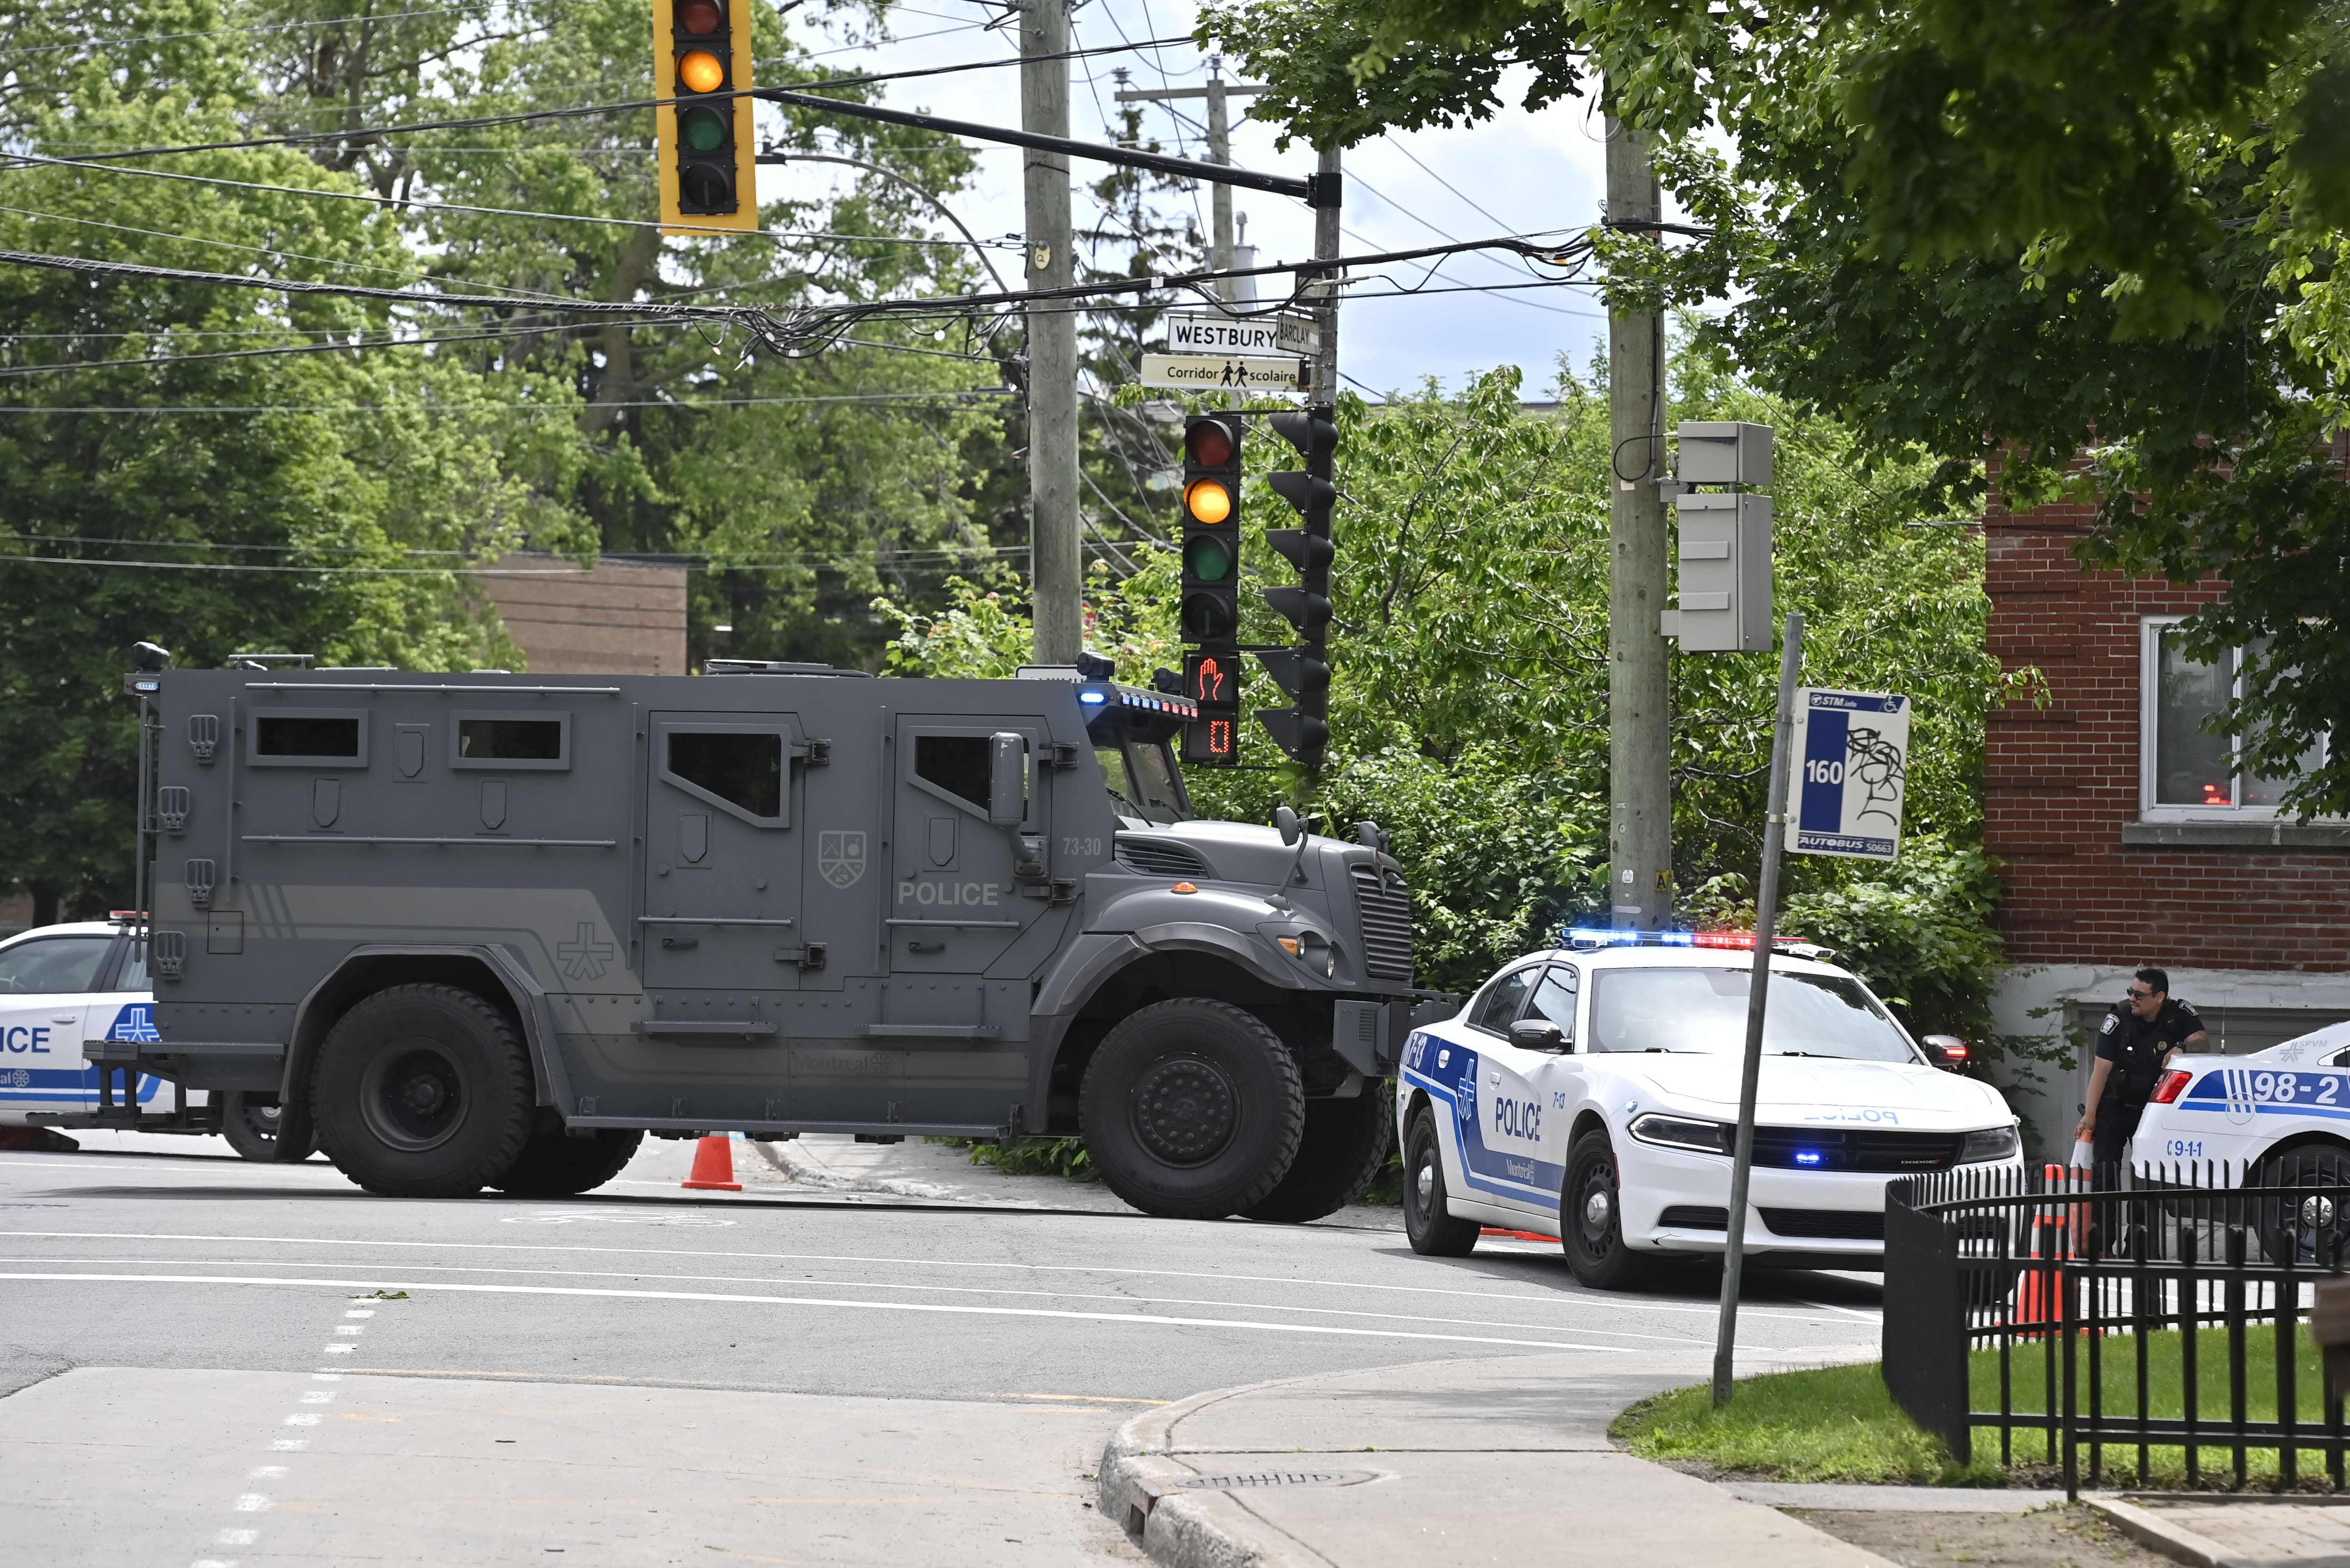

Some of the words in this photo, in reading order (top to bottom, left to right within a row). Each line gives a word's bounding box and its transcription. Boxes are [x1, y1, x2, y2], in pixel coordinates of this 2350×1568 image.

[1176, 325, 1277, 347] WESTBURY
[1280, 322, 1309, 345] BARCLAY
[1167, 367, 1218, 379] Corridor
[1249, 369, 1296, 382] scolaire
[1806, 760, 1843, 784] 160
[1063, 838, 1101, 855] 73-30
[1799, 837, 1864, 848] AUTOBUS
[1866, 843, 1892, 853] 50663
[1657, 874, 1666, 889] A
[898, 882, 999, 906] POLICE
[1407, 1033, 1427, 1069] 7-13
[2254, 1072, 2339, 1104] 98-2
[1552, 1091, 1565, 1109] 7-13
[1496, 1097, 1541, 1141] POLICE
[2175, 1140, 2202, 1157] 9-1-1
[1506, 1159, 1531, 1179] Montréal
